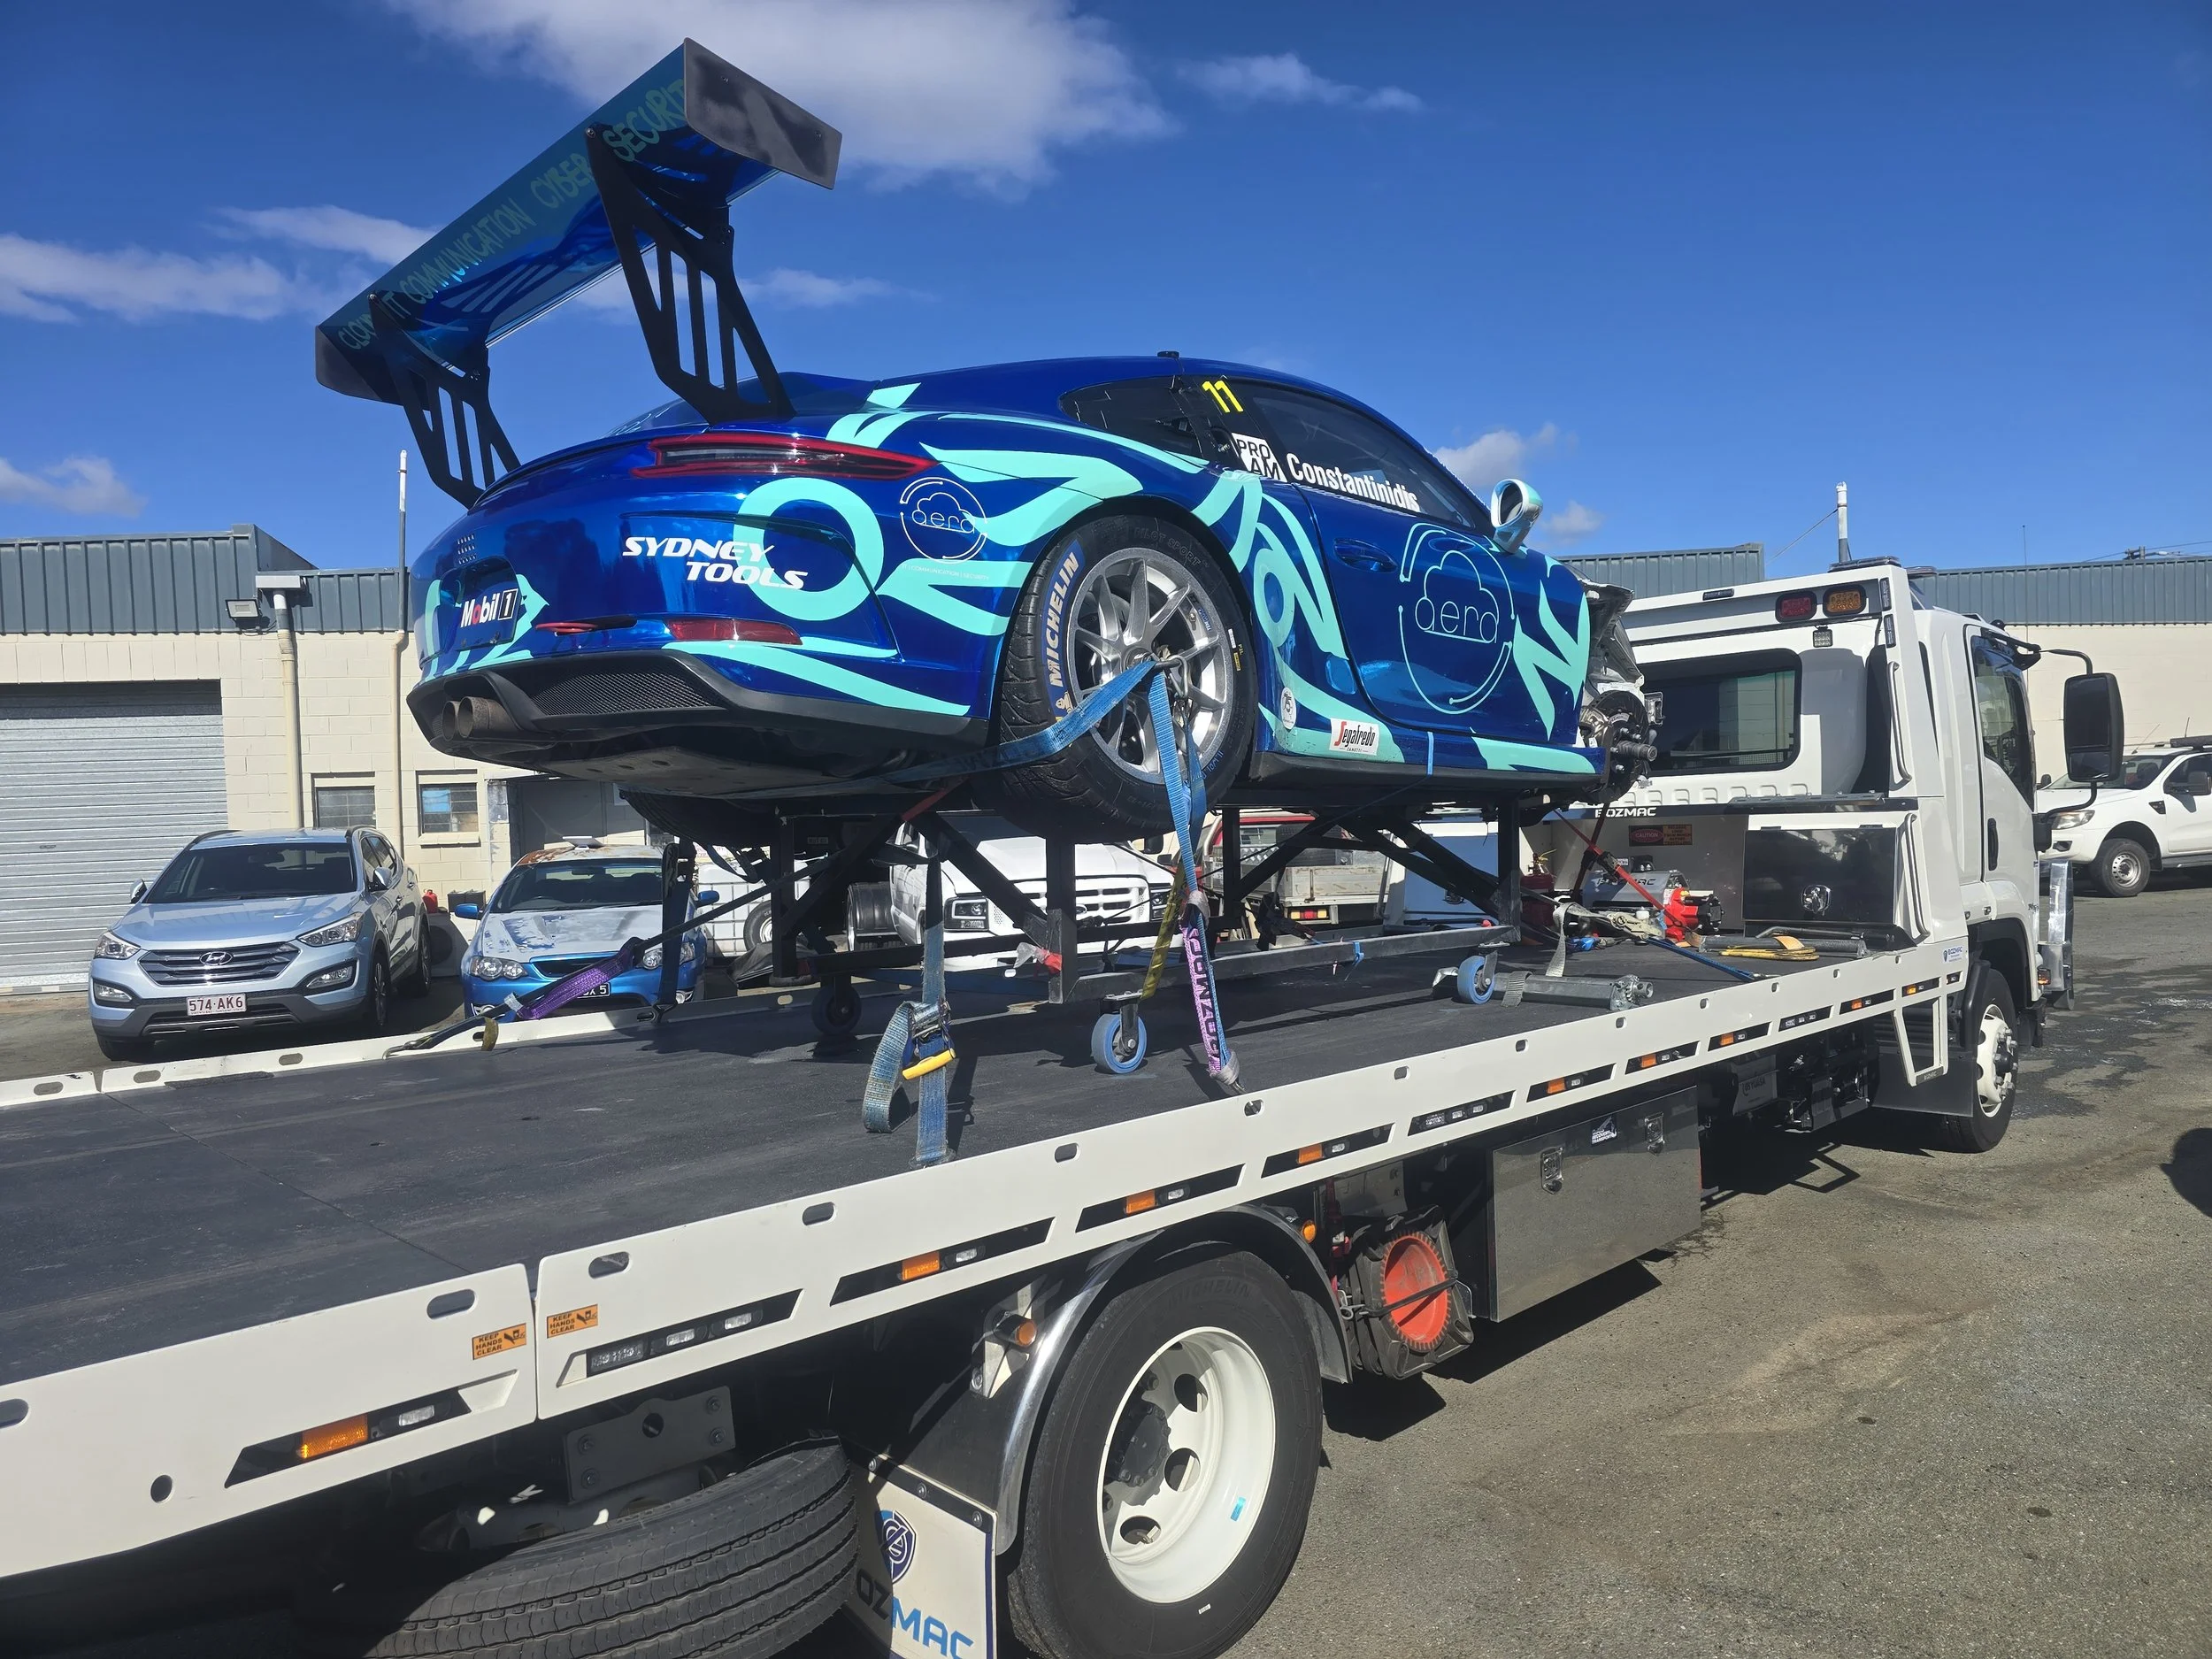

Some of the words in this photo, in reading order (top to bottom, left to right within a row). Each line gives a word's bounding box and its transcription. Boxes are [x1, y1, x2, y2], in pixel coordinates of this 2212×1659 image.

[381, 290, 412, 319] IT
[399, 197, 537, 304] COMMUNICATION
[603, 78, 687, 162] SECURIT
[1202, 380, 1244, 413] 11
[1236, 438, 1271, 459] PRO
[1250, 457, 1281, 481] AM
[1286, 452, 1422, 513] Constantinidis
[622, 536, 775, 563] SYDNEY
[686, 561, 809, 590] TOOLS
[910, 565, 960, 576] COMMUNICATION
[963, 572, 990, 580] SECURITY
[460, 592, 501, 628] Mobil
[1043, 551, 1079, 687] MICHELIN
[1333, 721, 1376, 748] Segafredo
[549, 1318, 575, 1329] HANDS
[550, 1325, 575, 1335] CLEAR
[553, 1313, 572, 1323] KEEP
[475, 1338, 503, 1350] HANDS
[476, 1344, 503, 1356] CLEAR
[479, 1333, 499, 1343] KEEP
[856, 1568, 974, 1659] OZMAC
